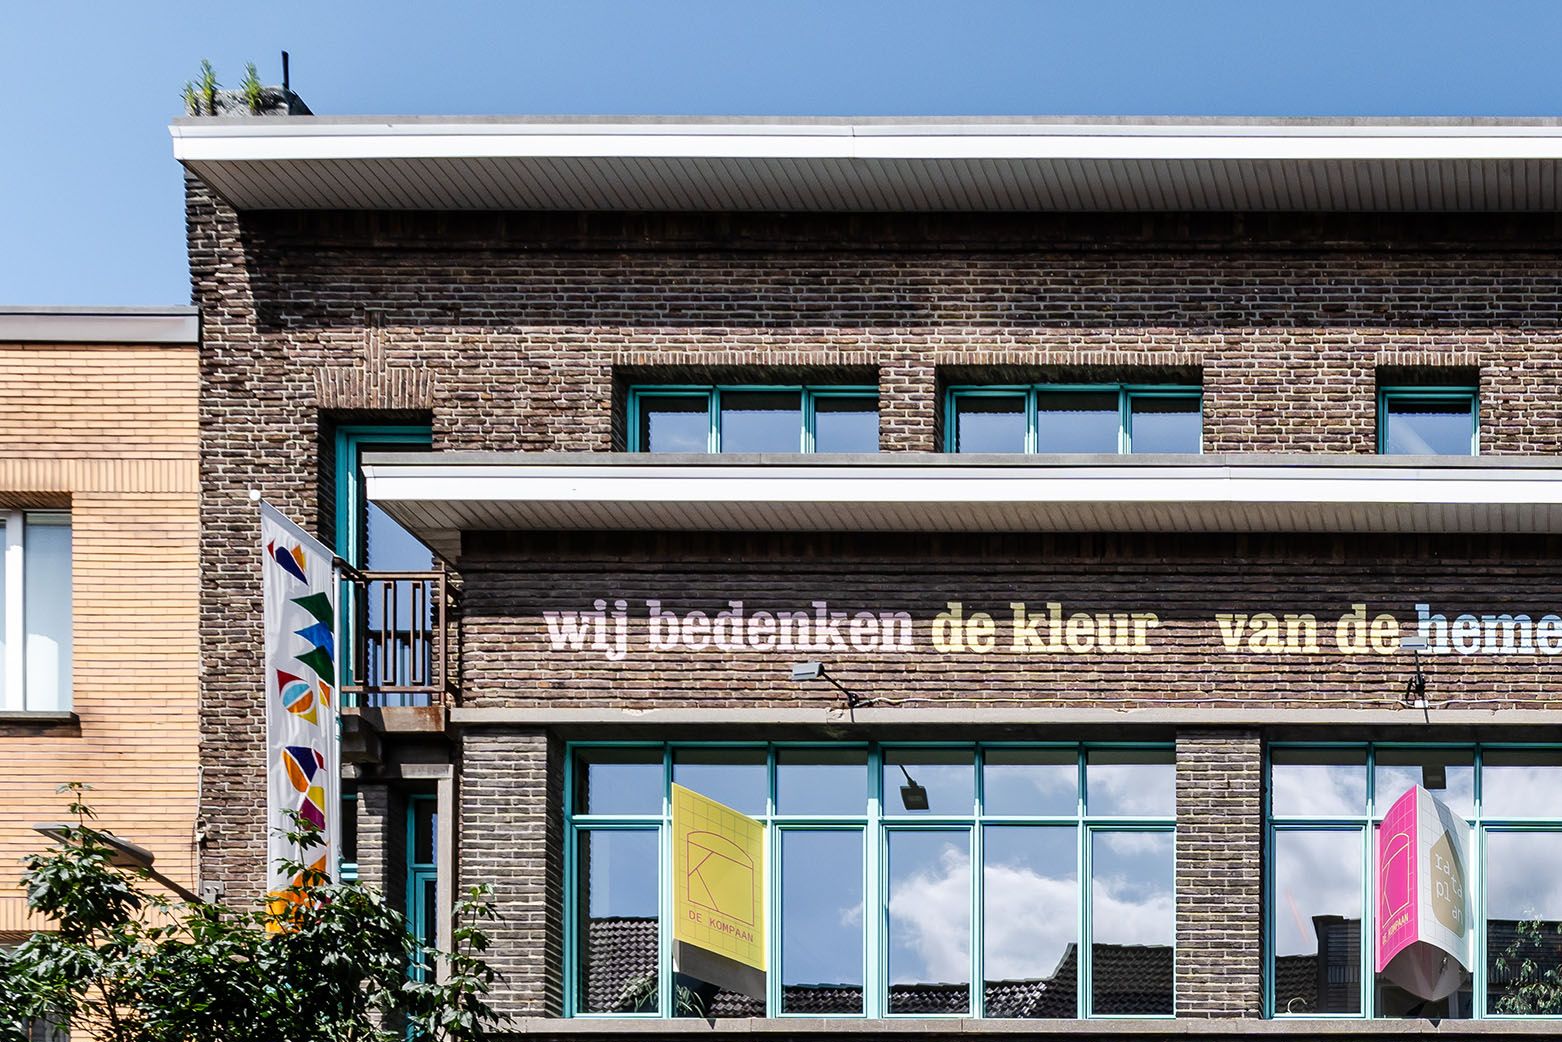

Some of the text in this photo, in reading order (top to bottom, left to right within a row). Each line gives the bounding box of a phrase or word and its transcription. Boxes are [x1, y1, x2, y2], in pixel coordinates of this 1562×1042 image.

[542, 599, 628, 660] wij
[647, 600, 913, 653] bedenken
[931, 602, 996, 654] de
[1009, 602, 1160, 654] kleur
[1215, 611, 1332, 655] van
[1335, 604, 1400, 655] de
[688, 909, 754, 943] DE KOMPAAN
